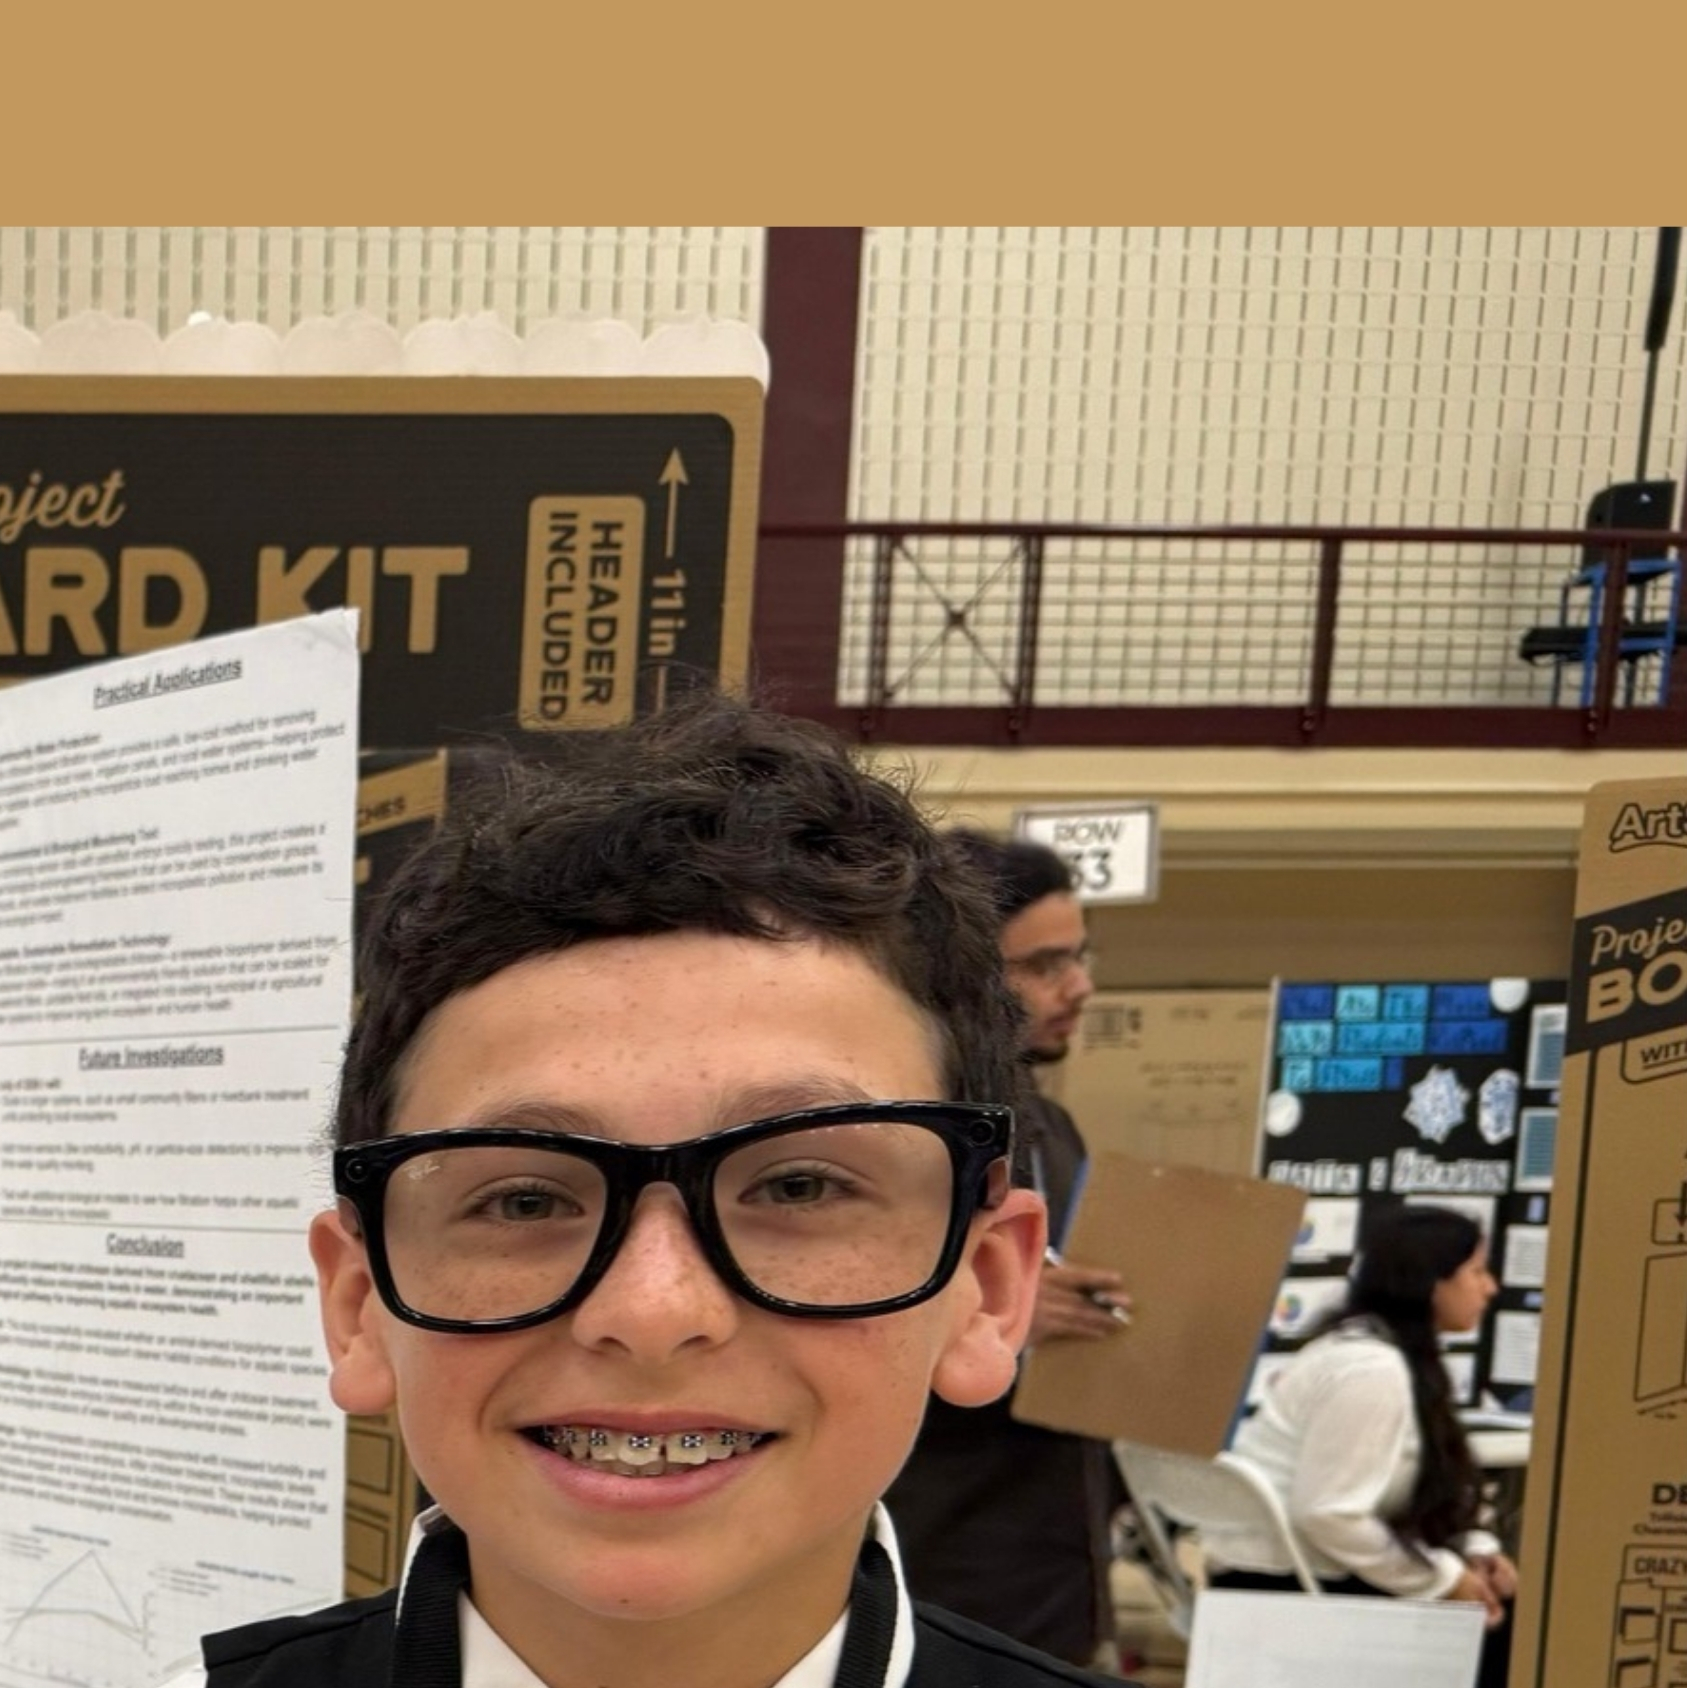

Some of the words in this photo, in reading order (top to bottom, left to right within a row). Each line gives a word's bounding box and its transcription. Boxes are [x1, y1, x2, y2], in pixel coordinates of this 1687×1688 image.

[256, 547, 469, 653] KIT
[539, 512, 578, 720] INCLUDED
[581, 521, 623, 705] HEADER
[93, 676, 151, 710] Practical
[153, 657, 242, 695] Applications
[1054, 821, 1124, 845] ROW
[1610, 803, 1687, 839] Art
[78, 1047, 120, 1070] Future
[125, 1045, 224, 1069] Investigations
[1641, 1041, 1687, 1066] WIT
[107, 1232, 185, 1258] Conclusion
